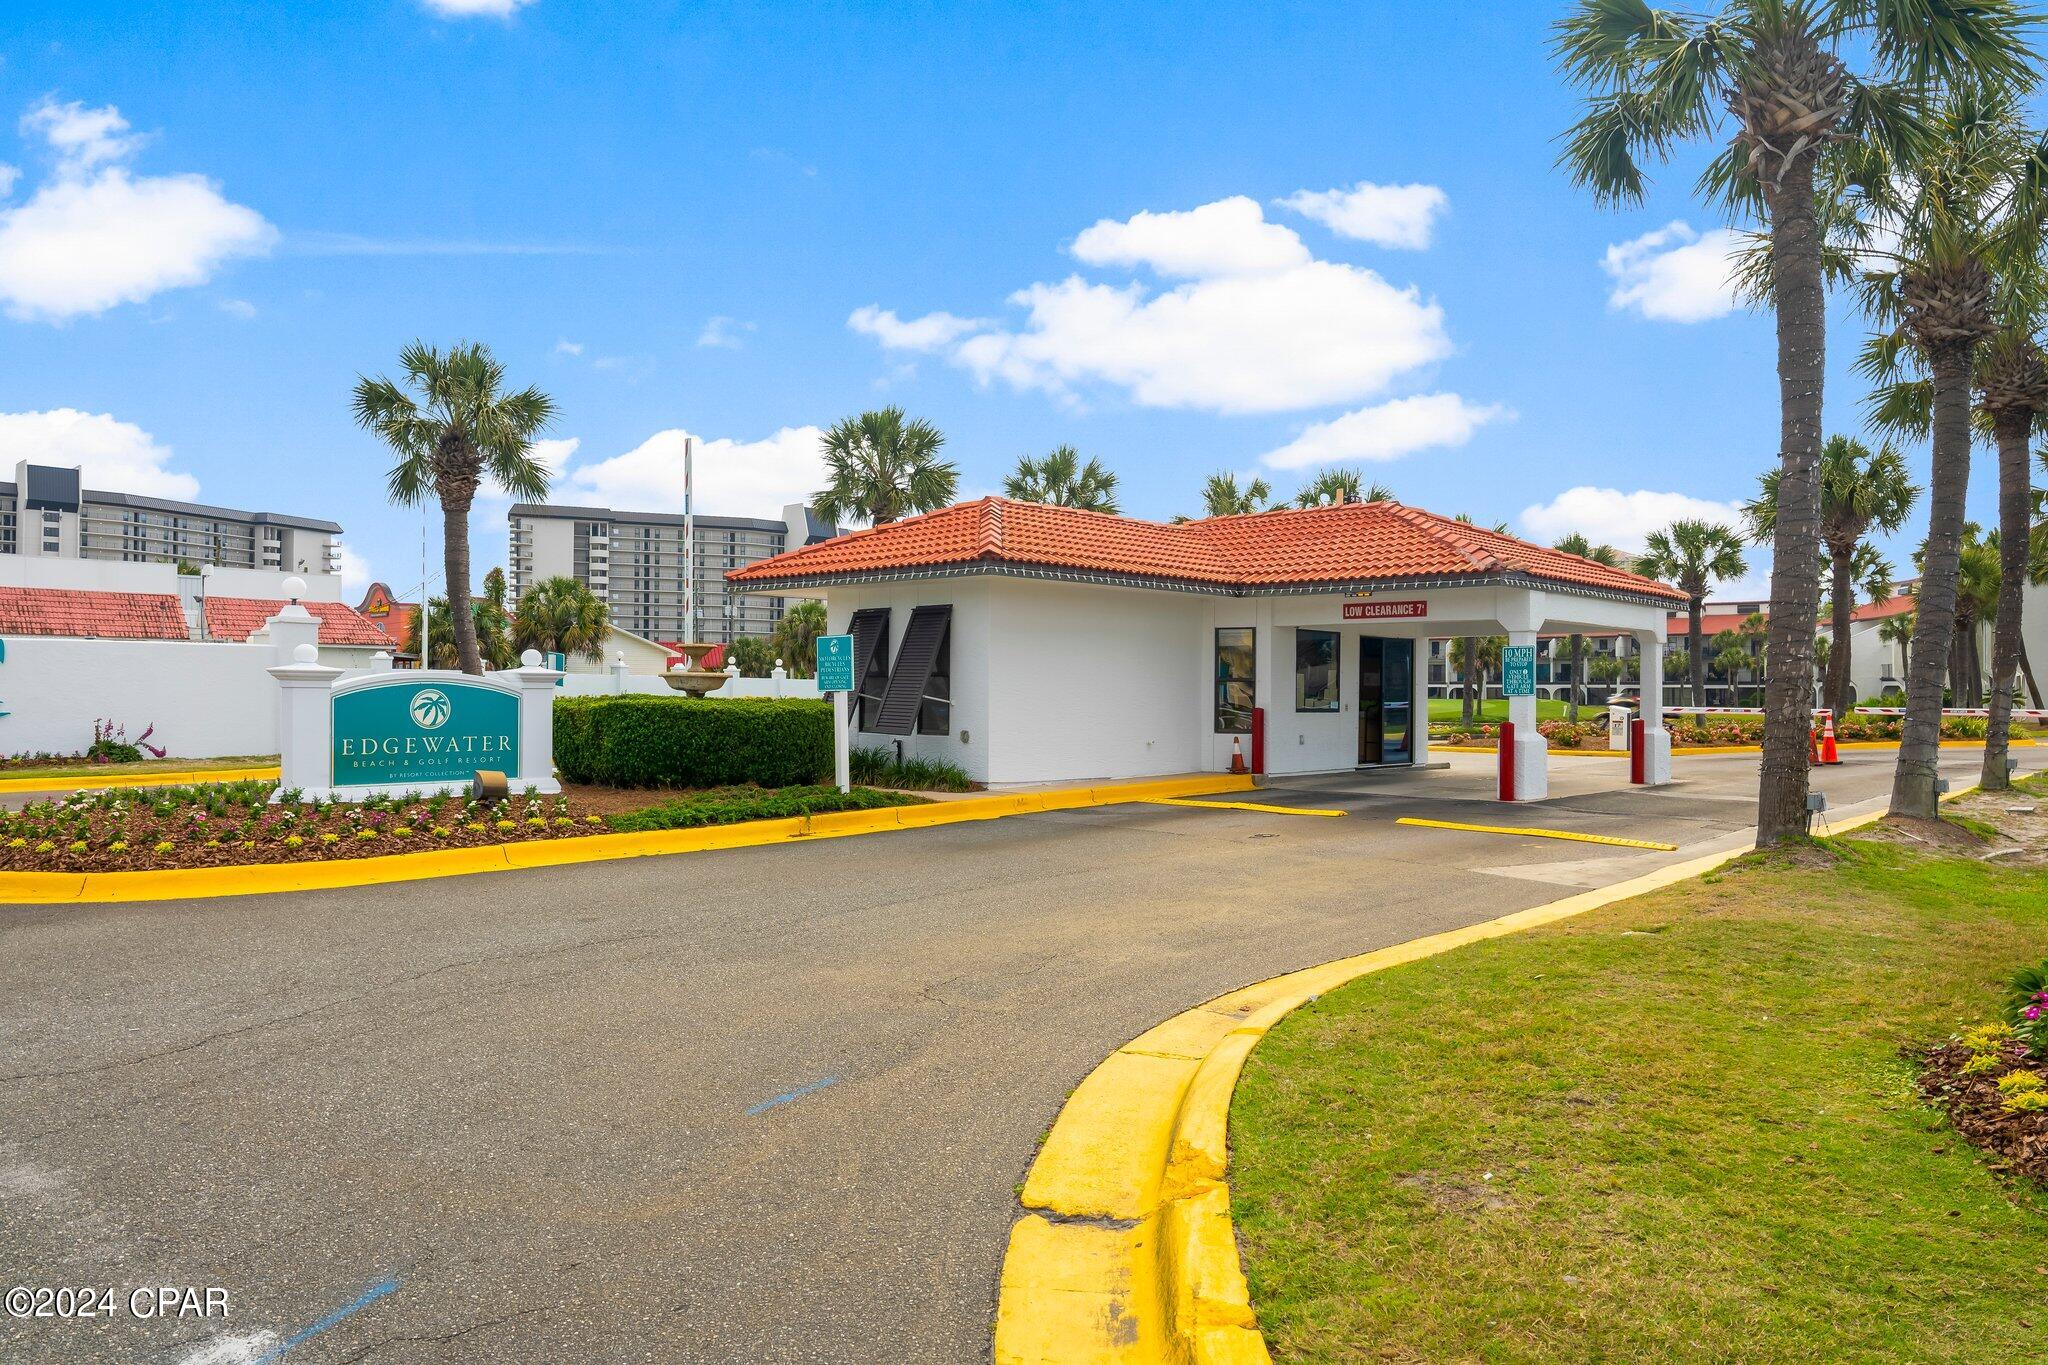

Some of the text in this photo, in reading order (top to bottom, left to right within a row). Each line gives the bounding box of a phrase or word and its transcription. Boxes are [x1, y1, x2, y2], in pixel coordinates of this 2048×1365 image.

[1345, 606, 1363, 617] LOW
[1365, 604, 1414, 616] CLEARANCE
[1504, 648, 1532, 658] 10 MPH
[342, 735, 512, 756] EDGEWATER
[353, 760, 395, 768] BEACH
[418, 758, 450, 766] GOLF
[458, 756, 502, 764] RESORT
